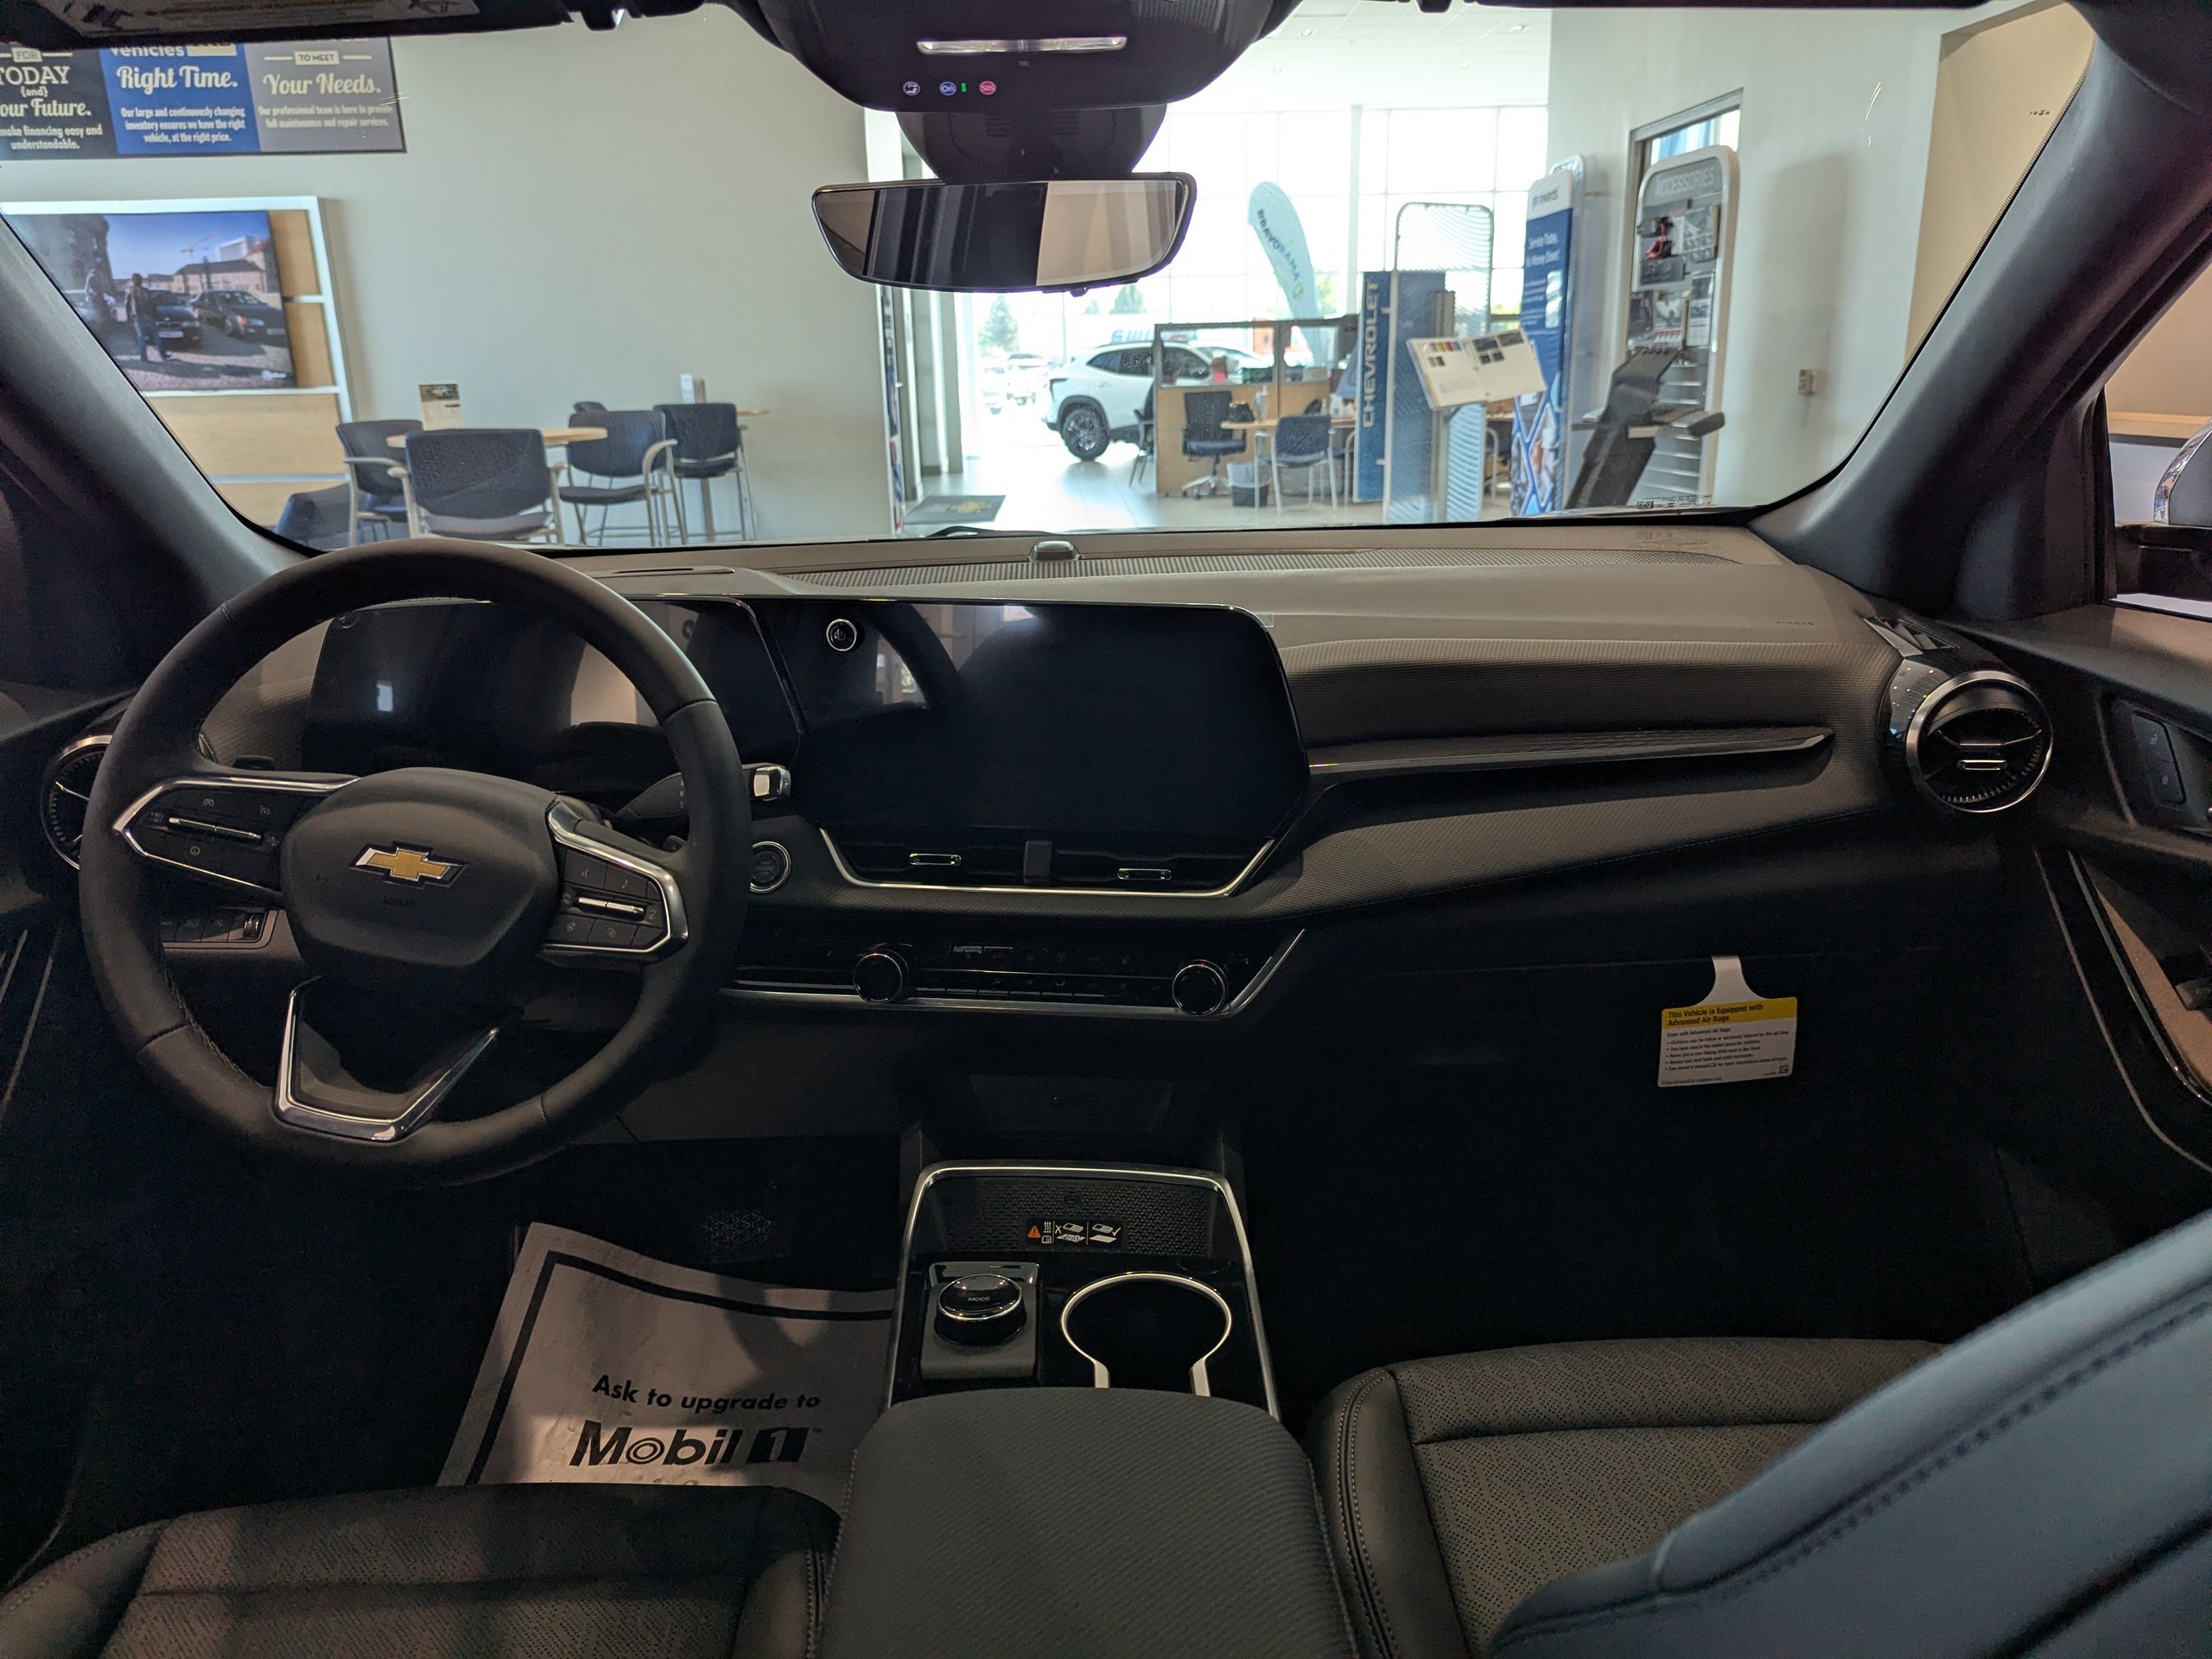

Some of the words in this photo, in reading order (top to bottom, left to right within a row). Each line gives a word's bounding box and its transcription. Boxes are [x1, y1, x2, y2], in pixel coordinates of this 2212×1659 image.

[16, 51, 39, 60] FOR
[312, 54, 334, 62] MEET
[116, 65, 178, 95] Right
[179, 65, 238, 88] Time.
[263, 73, 313, 95] Your
[316, 72, 382, 94] Needs.
[0, 104, 29, 117] our
[31, 98, 92, 117] Future.
[120, 107, 134, 118] Our
[135, 106, 154, 119] large
[155, 106, 168, 118] and
[169, 106, 213, 118] continuously
[124, 120, 159, 131] inventory
[199, 119, 215, 130] have
[215, 119, 227, 130] the
[228, 118, 246, 130] right
[23, 124, 64, 139] financing
[65, 127, 84, 138] easy
[86, 124, 103, 136] and
[180, 132, 192, 143] the
[193, 132, 211, 144] right
[11, 138, 80, 150] understandable.
[1363, 280, 1380, 429] CHEVROLET
[1684, 1007, 1707, 1017] Vehicle
[1716, 1004, 1747, 1016] Equipped
[1667, 1016, 1700, 1027] Advanced
[1701, 1015, 1713, 1024] Air
[1713, 1014, 1730, 1024] Bags
[591, 1374, 640, 1404] Ask
[646, 1388, 673, 1408] to
[681, 1392, 788, 1414] upgrade
[797, 1394, 821, 1409] to
[569, 1419, 744, 1467] Mobil
